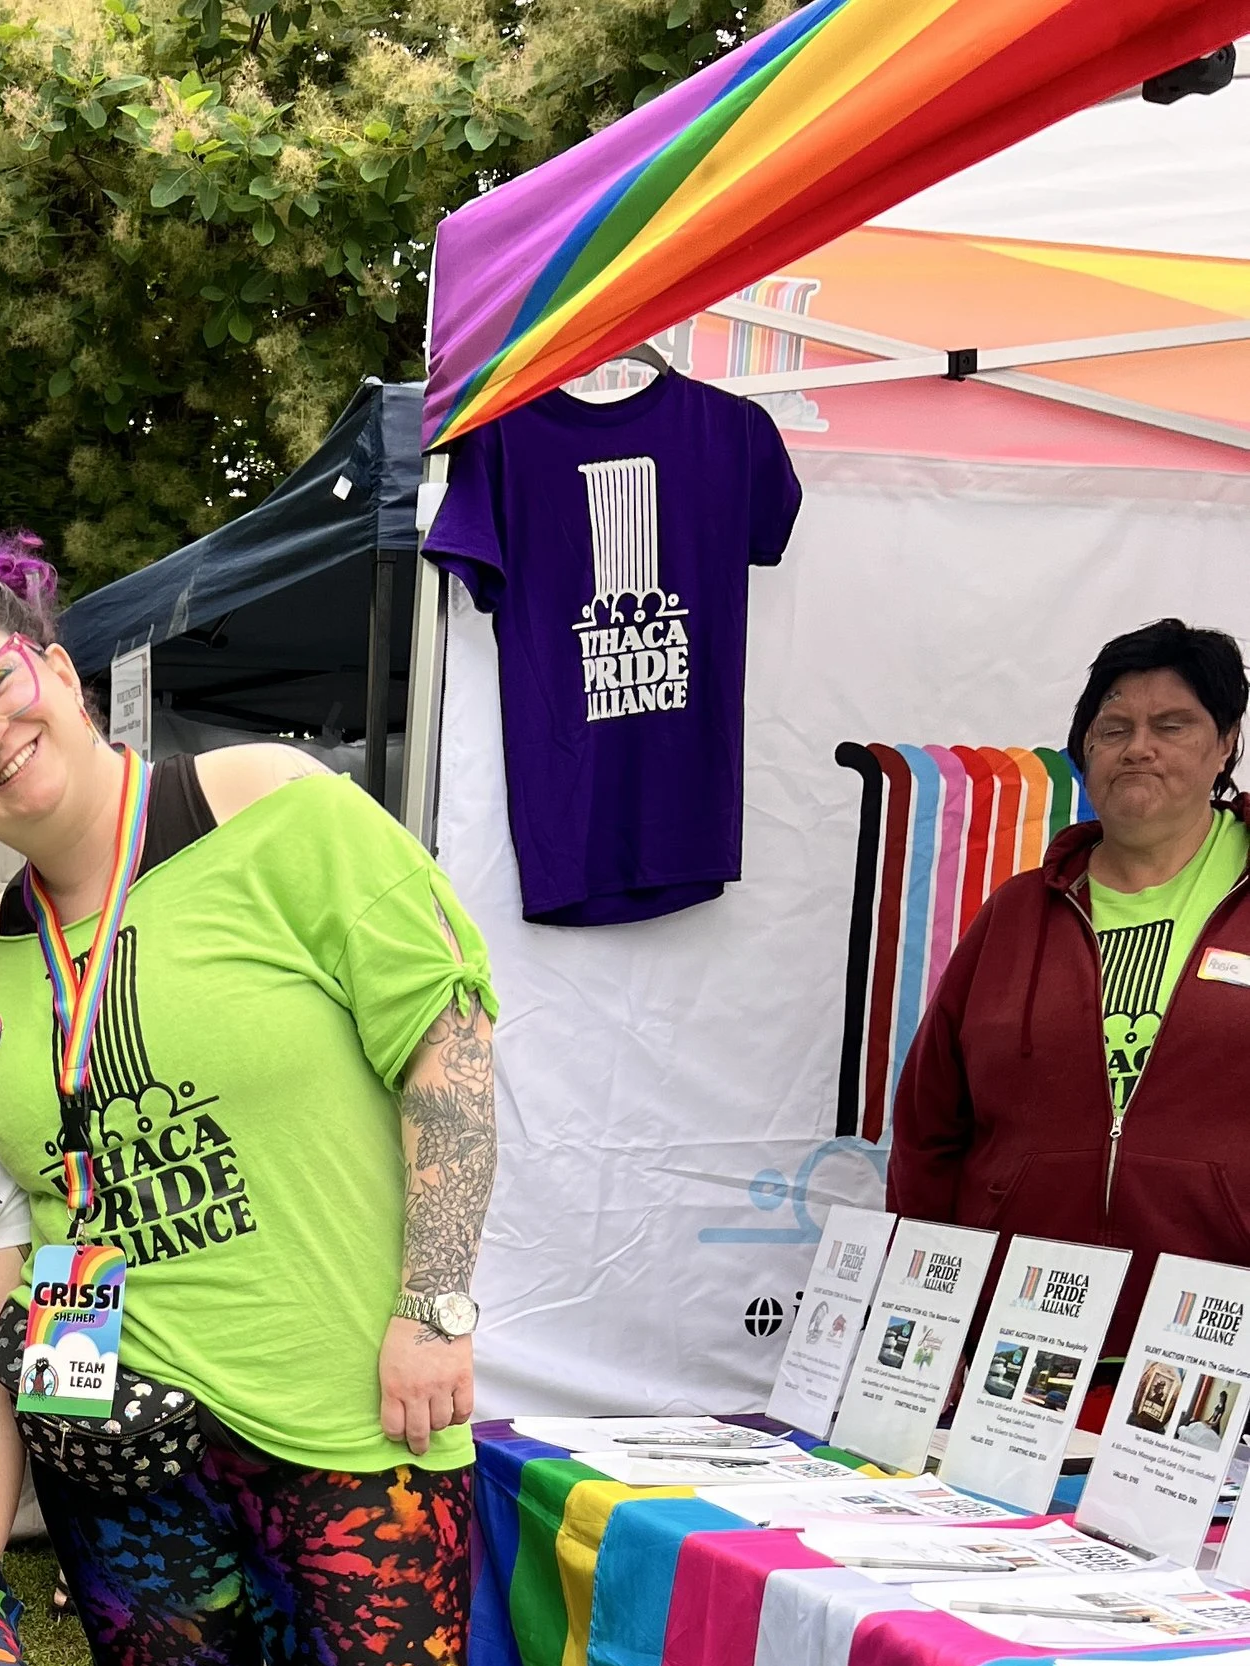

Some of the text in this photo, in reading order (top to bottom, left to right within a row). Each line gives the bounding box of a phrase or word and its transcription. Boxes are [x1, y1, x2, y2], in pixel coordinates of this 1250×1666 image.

[578, 619, 689, 658] ITHACA
[582, 645, 689, 693] PRIDE
[51, 1112, 232, 1197] HACA
[73, 1193, 257, 1269] LIANCE
[840, 1253, 866, 1271] PRIDE
[930, 1252, 962, 1268] ITHACA
[926, 1264, 961, 1282] PRIDE
[1048, 1269, 1090, 1288] ITHACA
[34, 1281, 121, 1310] CRISSI
[922, 1277, 956, 1294] ALLIANCE
[1043, 1282, 1089, 1304] PRIDE
[1038, 1298, 1082, 1318] ALLIANCE
[1202, 1296, 1244, 1316] ITHACA
[53, 1312, 96, 1324] SHE/HER
[1197, 1308, 1243, 1332] PRIDE
[1192, 1325, 1237, 1346] ALLIANCE
[69, 1360, 106, 1374] TEAM
[69, 1376, 102, 1389] LEAD
